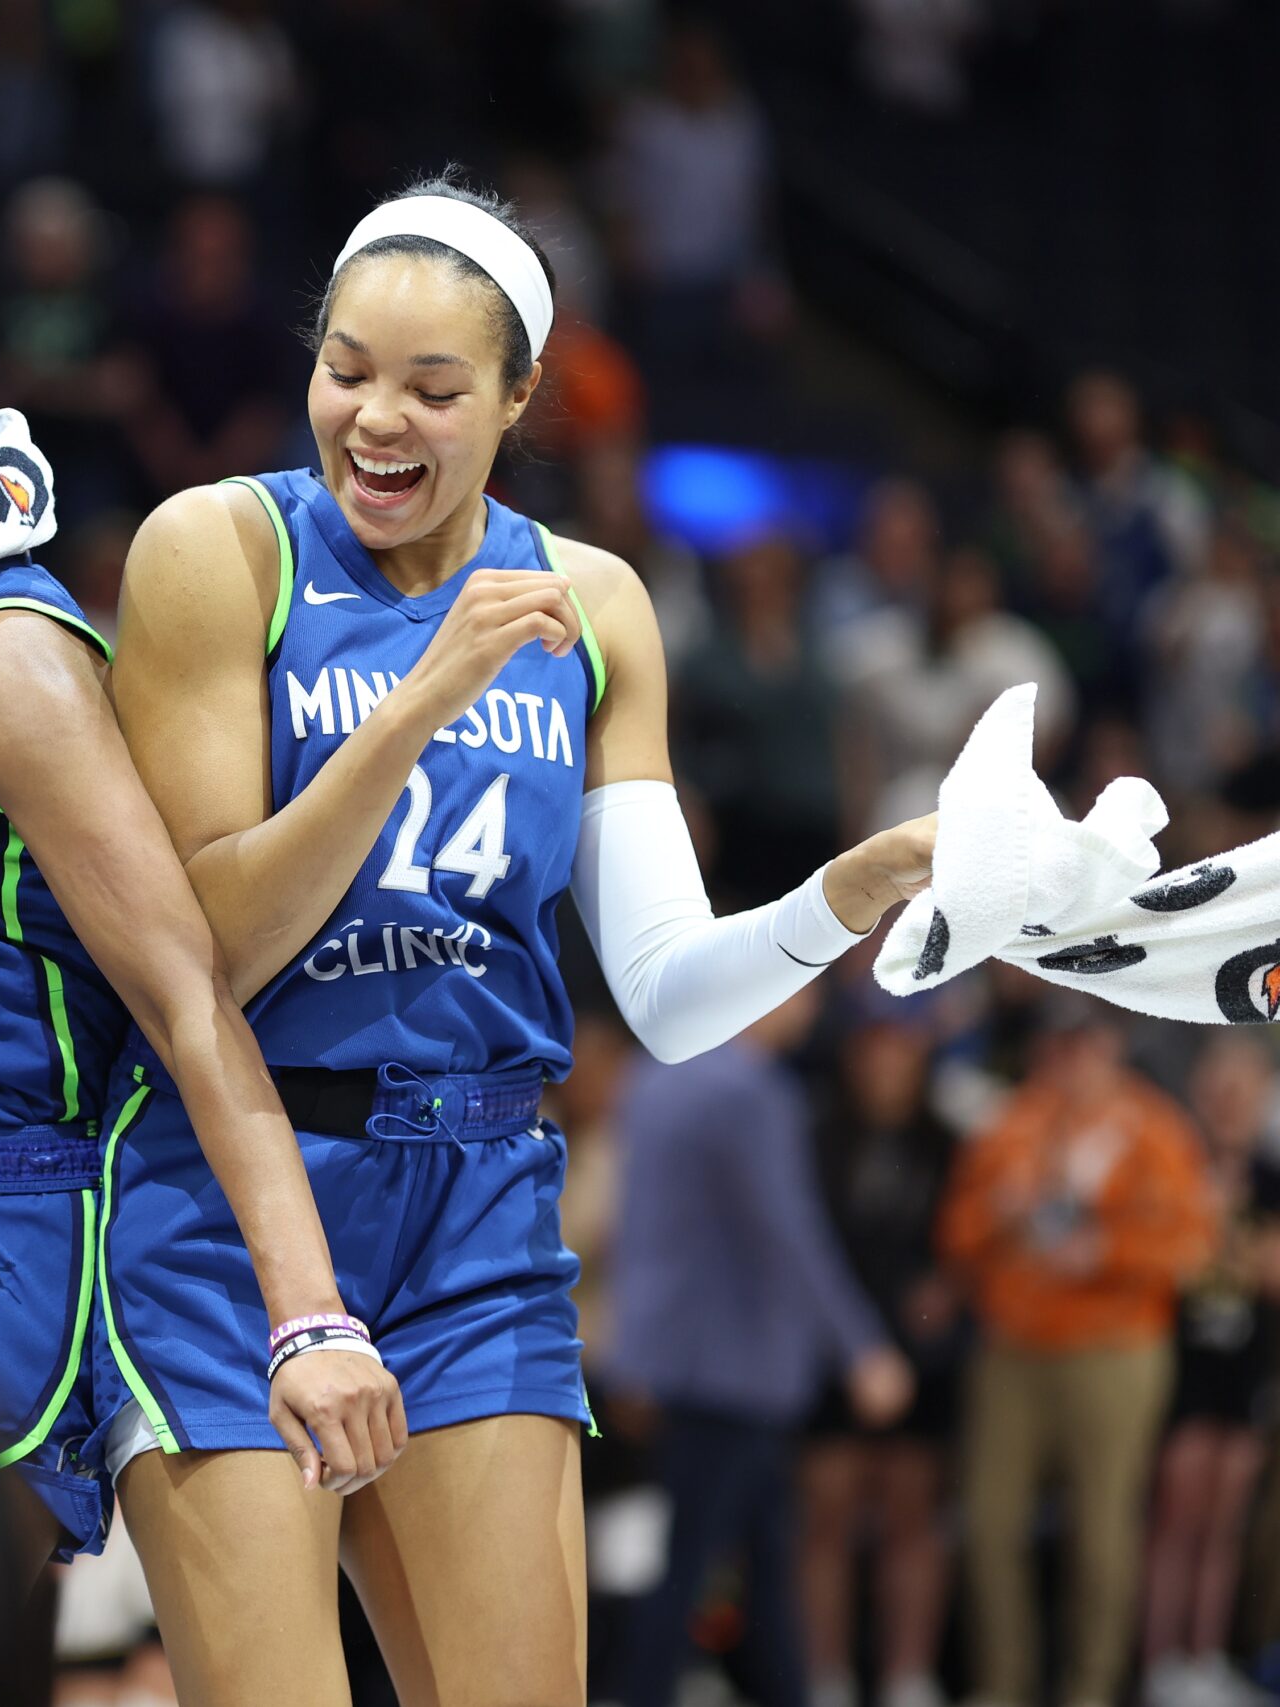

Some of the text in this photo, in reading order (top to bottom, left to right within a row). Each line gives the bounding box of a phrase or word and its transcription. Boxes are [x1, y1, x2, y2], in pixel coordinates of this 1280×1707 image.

[378, 764, 511, 899] 24
[304, 919, 492, 982] CLINIC
[270, 1313, 344, 1347] LUNAR
